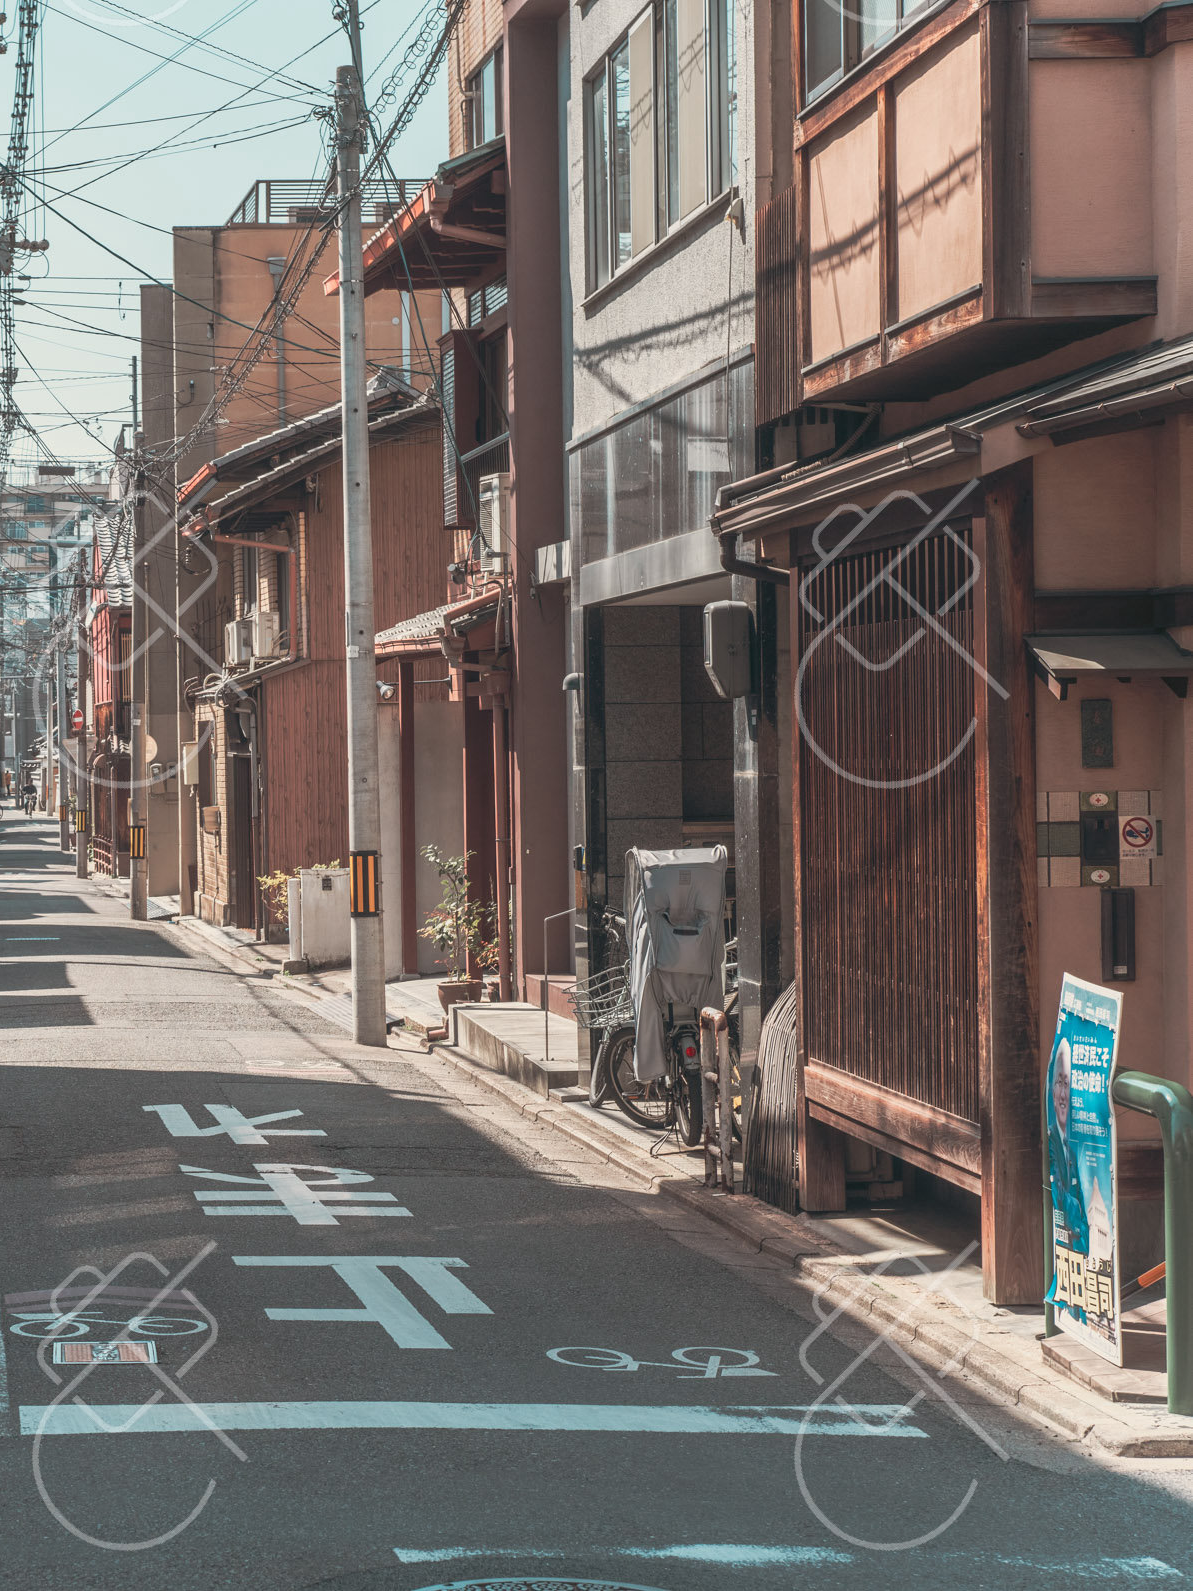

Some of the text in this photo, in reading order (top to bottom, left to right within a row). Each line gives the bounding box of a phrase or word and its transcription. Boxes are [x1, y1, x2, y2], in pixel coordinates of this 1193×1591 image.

[1072, 1044, 1110, 1068] 経世済民こそ
[142, 1102, 495, 1350] 止まれ
[1054, 1244, 1115, 1320] 西田昌司
